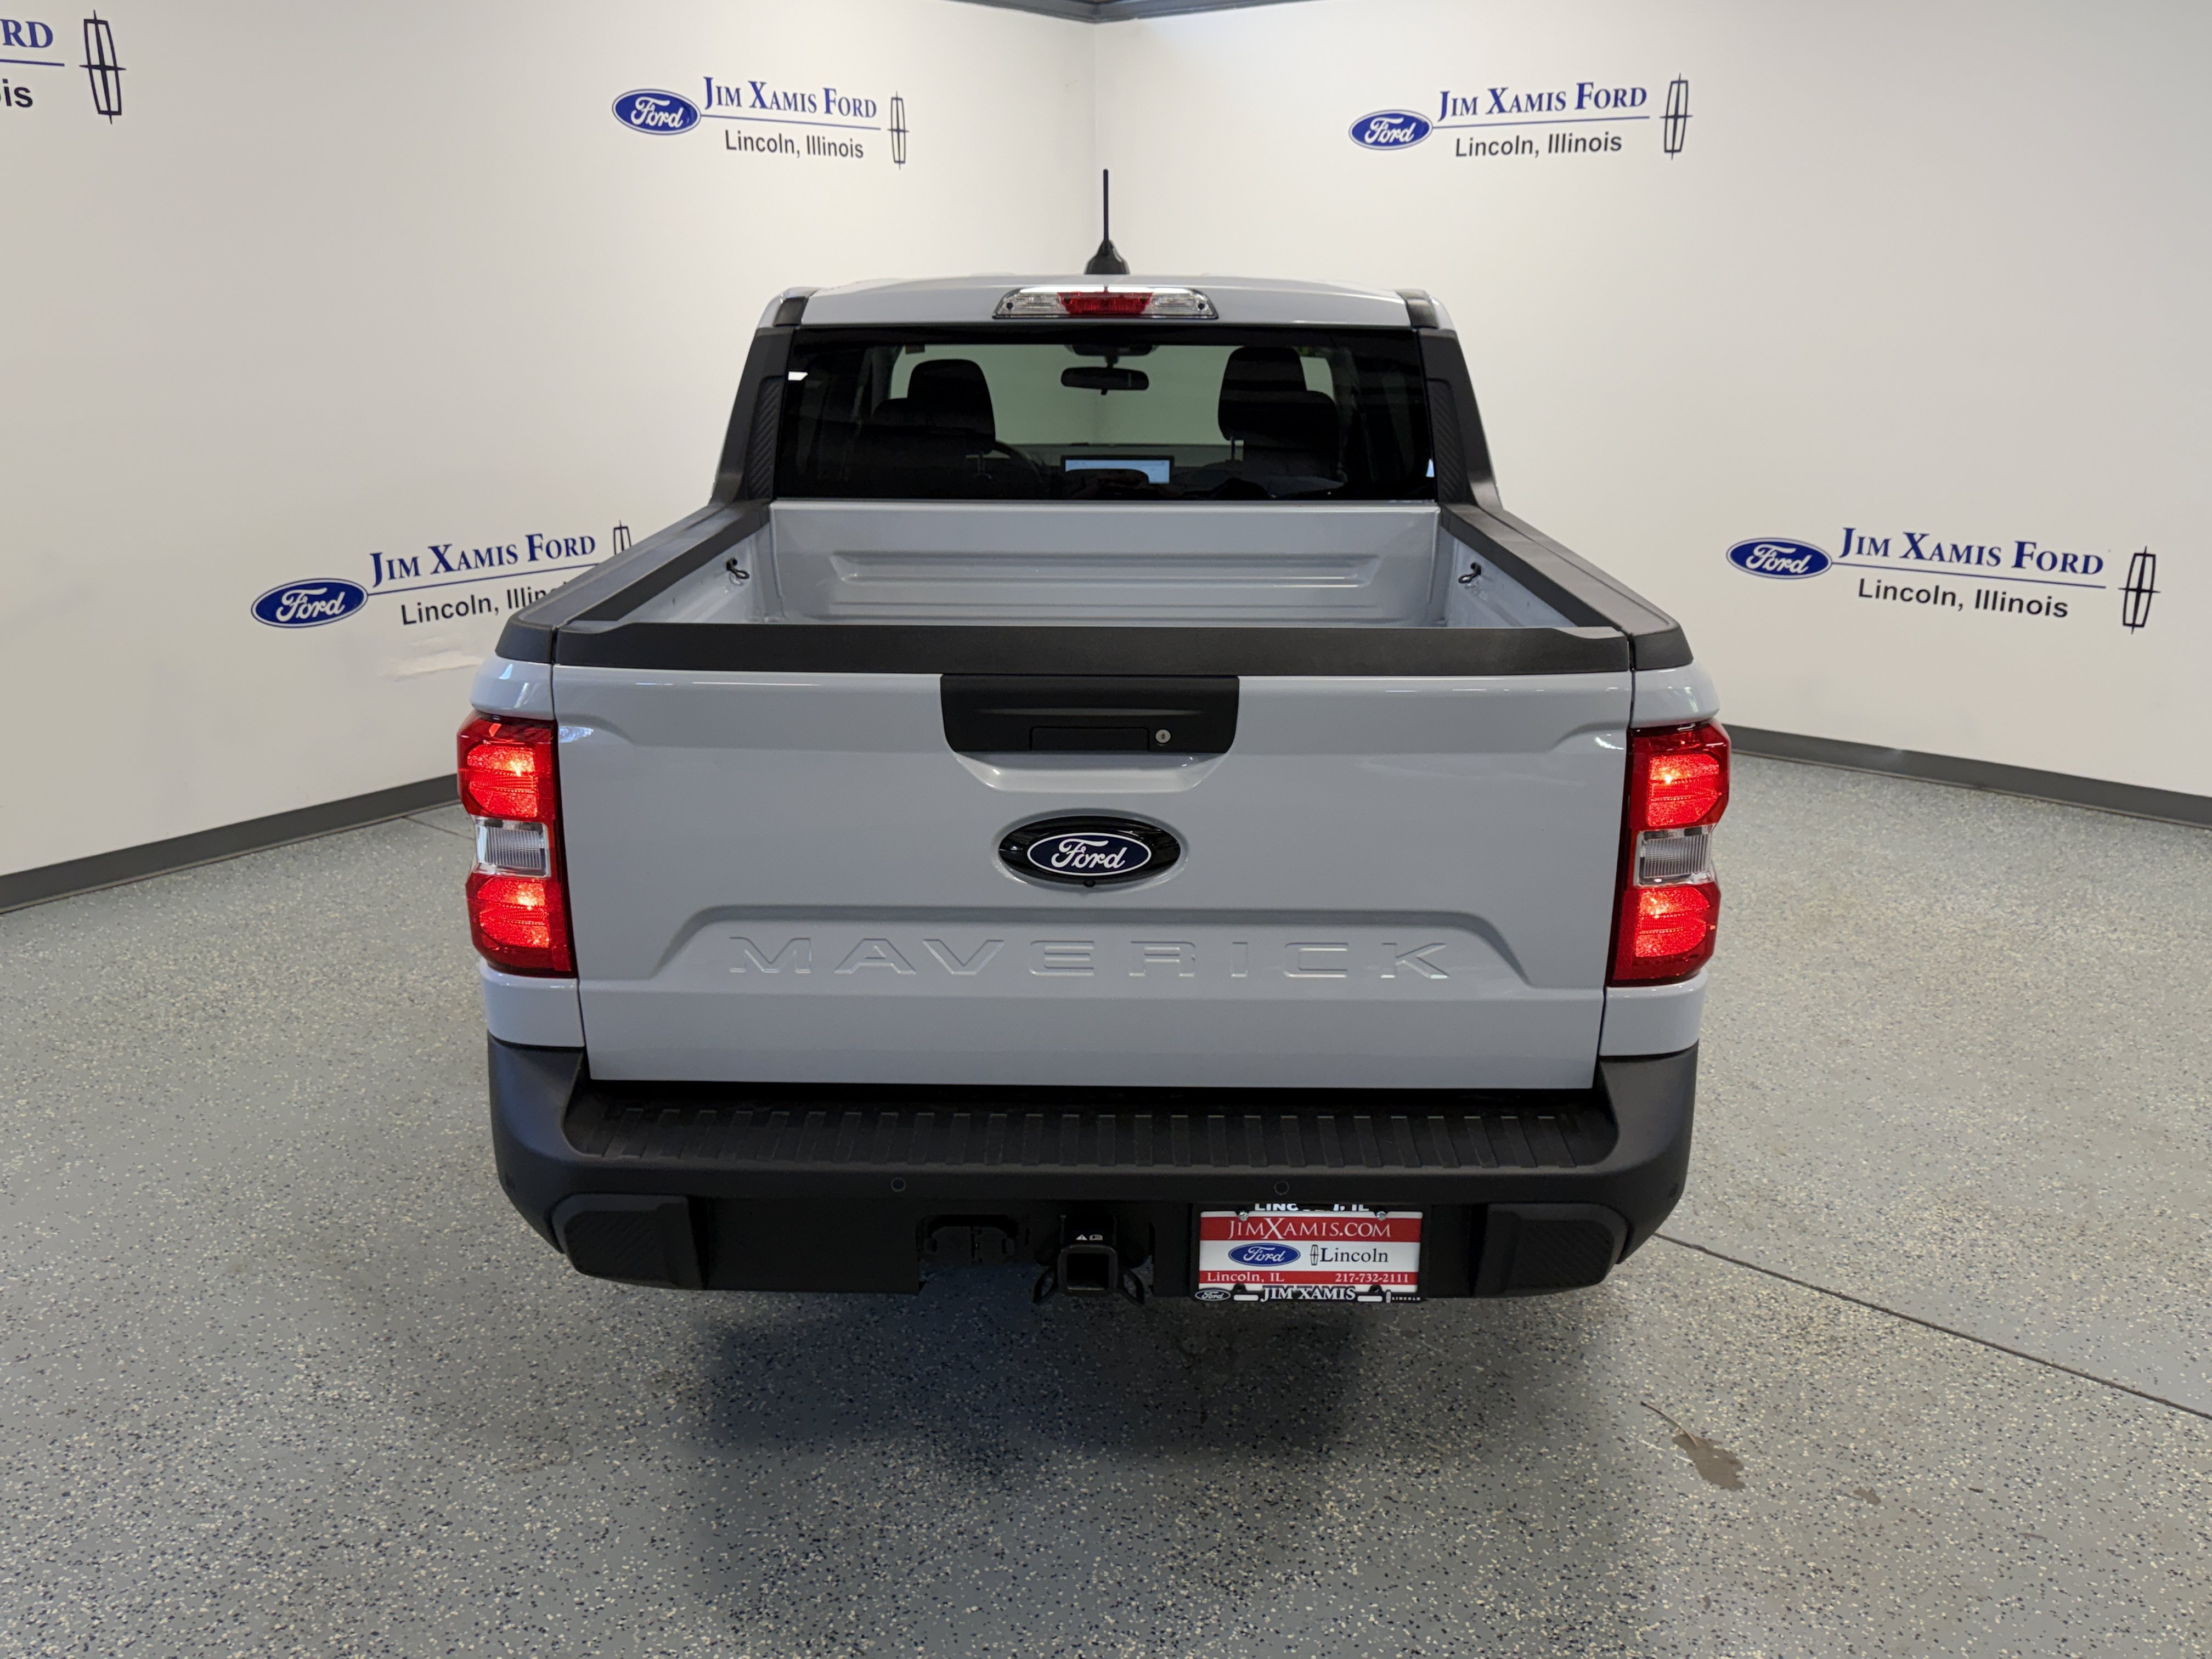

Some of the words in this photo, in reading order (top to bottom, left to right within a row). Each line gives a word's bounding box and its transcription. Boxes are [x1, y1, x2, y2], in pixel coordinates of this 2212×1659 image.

[0, 78, 33, 108] is
[703, 76, 742, 109] JIM
[747, 81, 817, 114] XAMIS
[822, 87, 877, 119] FORD
[1438, 91, 1479, 121] JIM
[1487, 87, 1566, 115] XAMIS
[1575, 82, 1647, 110] FORD
[630, 96, 685, 128] Ford
[725, 129, 800, 159] Lincoln,
[806, 135, 864, 159] Illinois
[1364, 118, 1415, 144] Ford
[1455, 135, 1539, 159] Lincoln,
[1548, 131, 1622, 154] Illinois
[369, 552, 421, 588] JIM
[427, 544, 519, 575] XAMIS
[524, 534, 596, 562] FORD
[1746, 544, 1812, 574] Ford
[1838, 527, 1892, 558] JIM
[1901, 533, 2002, 567] XAMIS
[2011, 540, 2104, 575] FORD
[275, 588, 346, 622] Ford
[400, 594, 499, 625] Lincoln,
[507, 582, 566, 609] Illin
[1858, 578, 1965, 612] Lincoln,
[1975, 589, 2069, 618] Illinois
[1051, 838, 1128, 870] Ford
[729, 936, 1451, 980] MAVERICK
[1228, 1217, 1391, 1240] JIMXAMIS.COM
[1243, 1246, 1286, 1262] Ford
[1320, 1248, 1389, 1262] Lincoln
[1207, 1272, 1265, 1283] Lincoln,
[1269, 1273, 1285, 1283] IL
[1335, 1273, 1409, 1283] 217-732-2111
[1201, 1290, 1224, 1300] Ford
[1260, 1287, 1294, 1302] JIM
[1299, 1286, 1356, 1300] XAMIS
